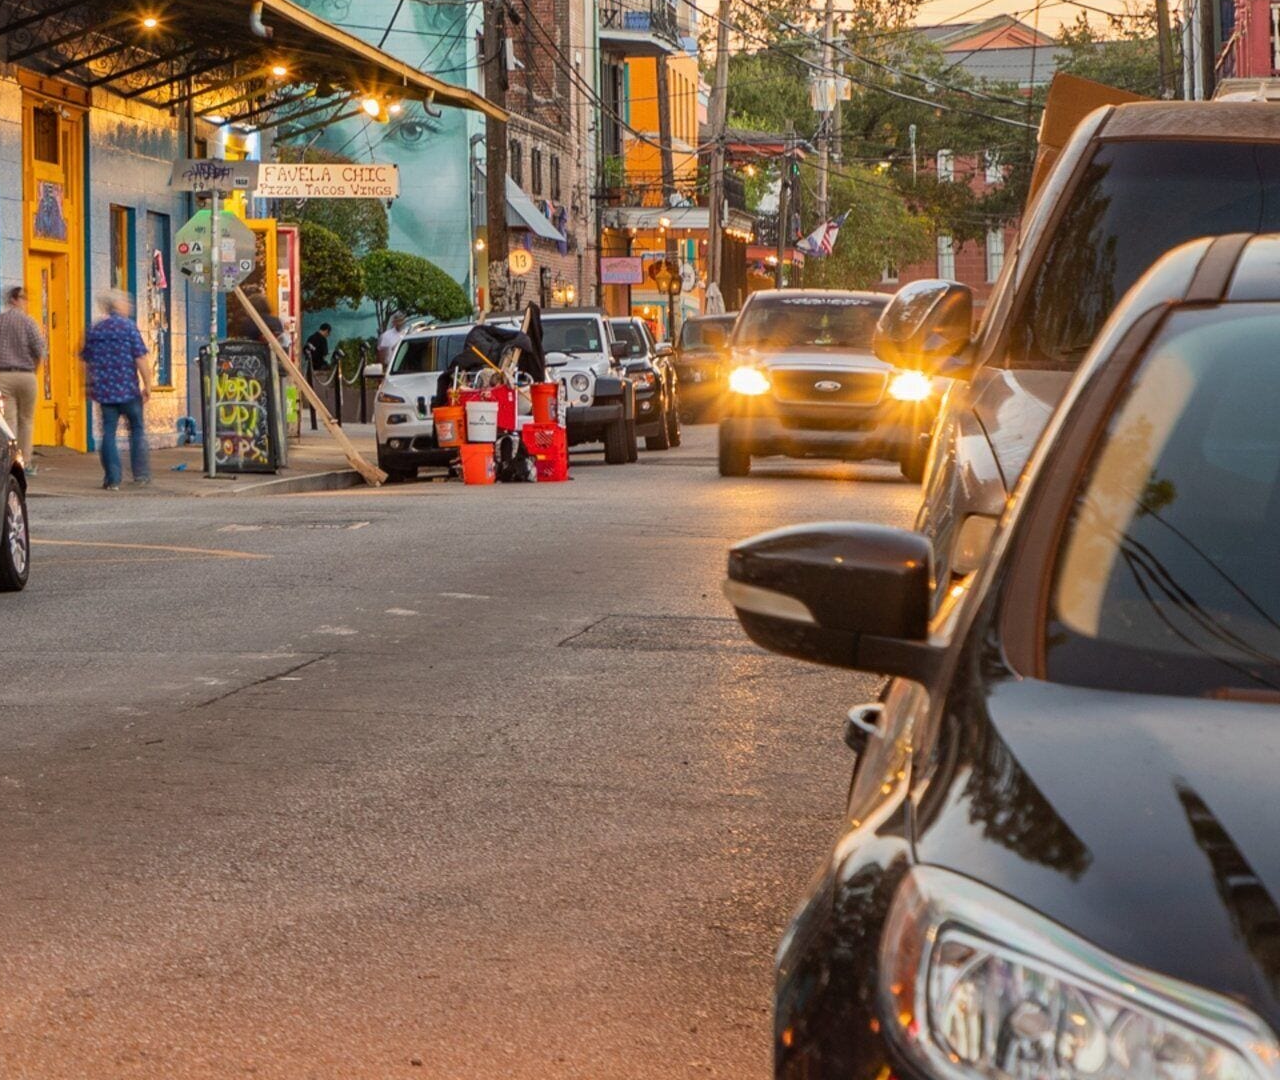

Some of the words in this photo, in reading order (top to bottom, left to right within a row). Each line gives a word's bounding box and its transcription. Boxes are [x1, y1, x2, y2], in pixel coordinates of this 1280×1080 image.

[264, 166, 332, 183] FAVELA
[342, 166, 387, 183] CHIC
[260, 183, 299, 196] PIZZA
[306, 183, 346, 196] TACOS
[515, 254, 527, 268] 13
